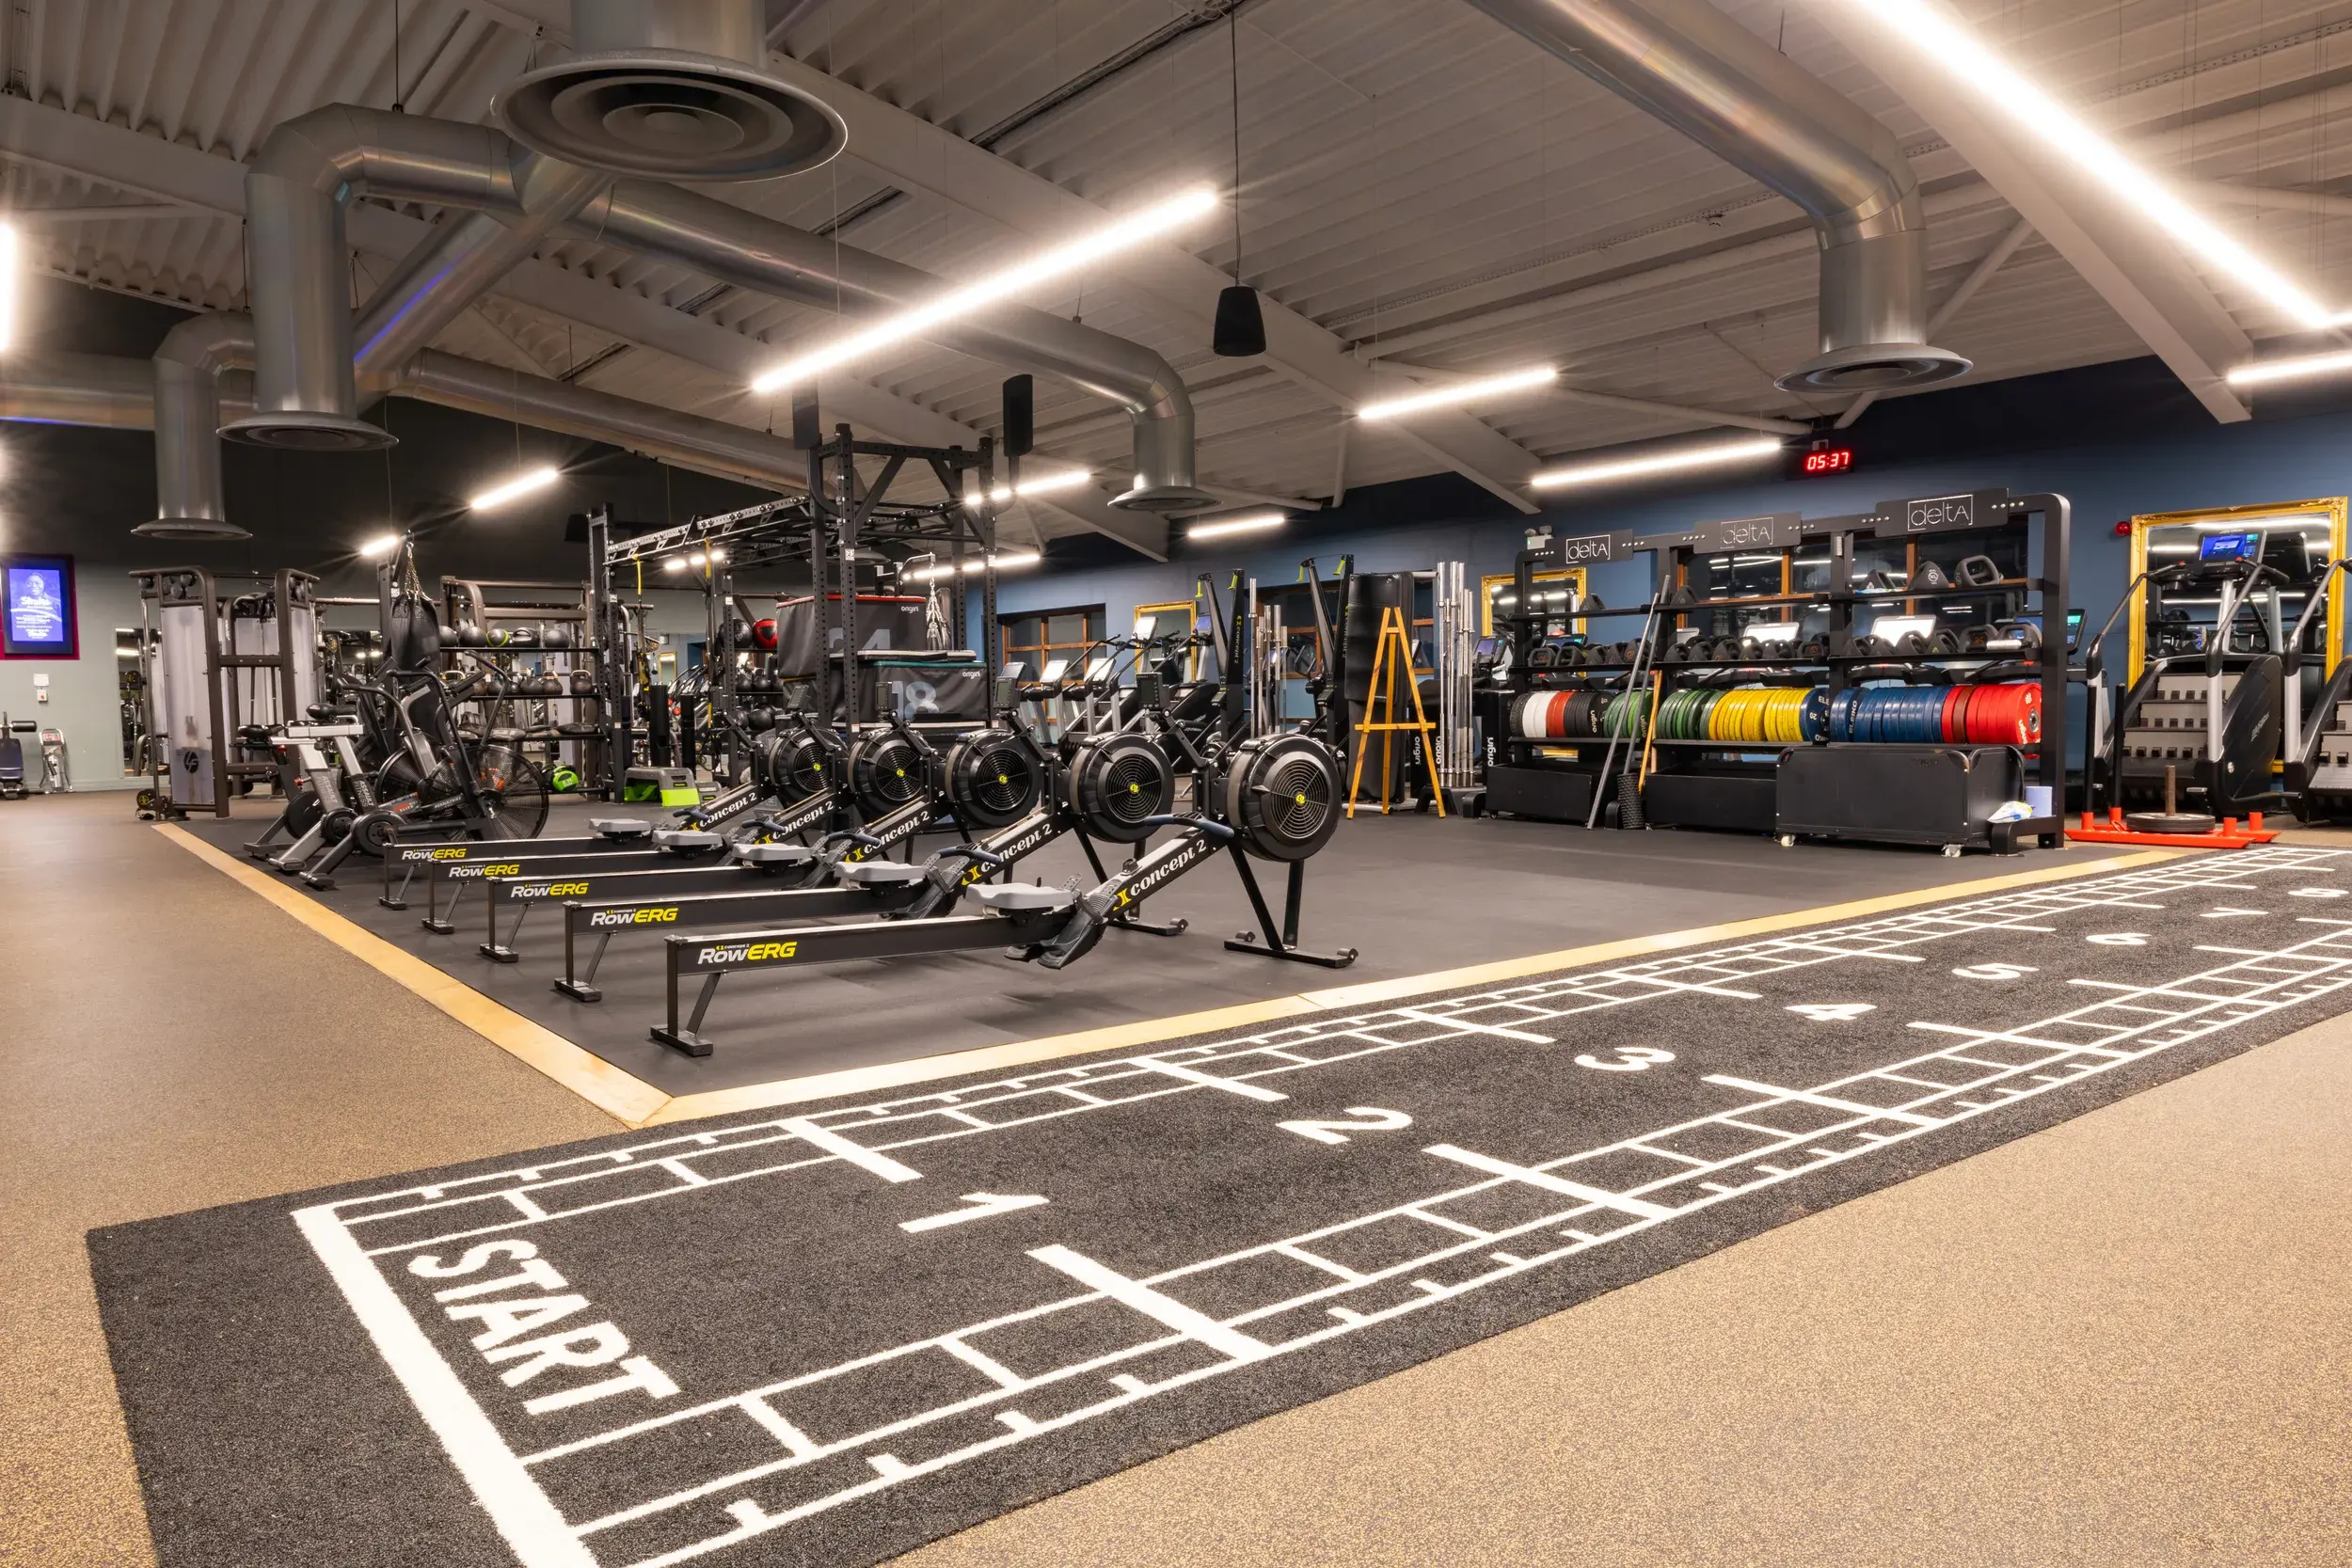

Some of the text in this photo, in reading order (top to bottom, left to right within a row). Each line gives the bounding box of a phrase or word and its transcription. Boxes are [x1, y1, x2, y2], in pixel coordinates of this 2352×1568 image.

[1807, 451, 1850, 470] 05:37
[901, 605, 919, 614] origin
[962, 671, 981, 680] origin
[1849, 700, 1857, 734] ELEIKO
[1413, 736, 1422, 765] origin
[1486, 736, 1496, 767] origin
[354, 781, 369, 807] FITNESS
[358, 781, 374, 806] ASSAULT
[826, 800, 834, 810] 2
[700, 792, 757, 828] concept 2
[922, 810, 930, 821] 2
[980, 823, 1053, 873] cncept 2
[1130, 839, 1207, 896] concept 2
[2288, 887, 2349, 898] 8
[2200, 907, 2269, 919] 7
[2085, 932, 2152, 946] 6
[1952, 962, 2040, 980] 5
[1784, 1003, 1878, 1022] 4
[1574, 1047, 1677, 1072] 3
[1275, 1106, 1413, 1146] 2
[898, 1192, 1050, 1234] 1
[407, 1239, 681, 1416] START
